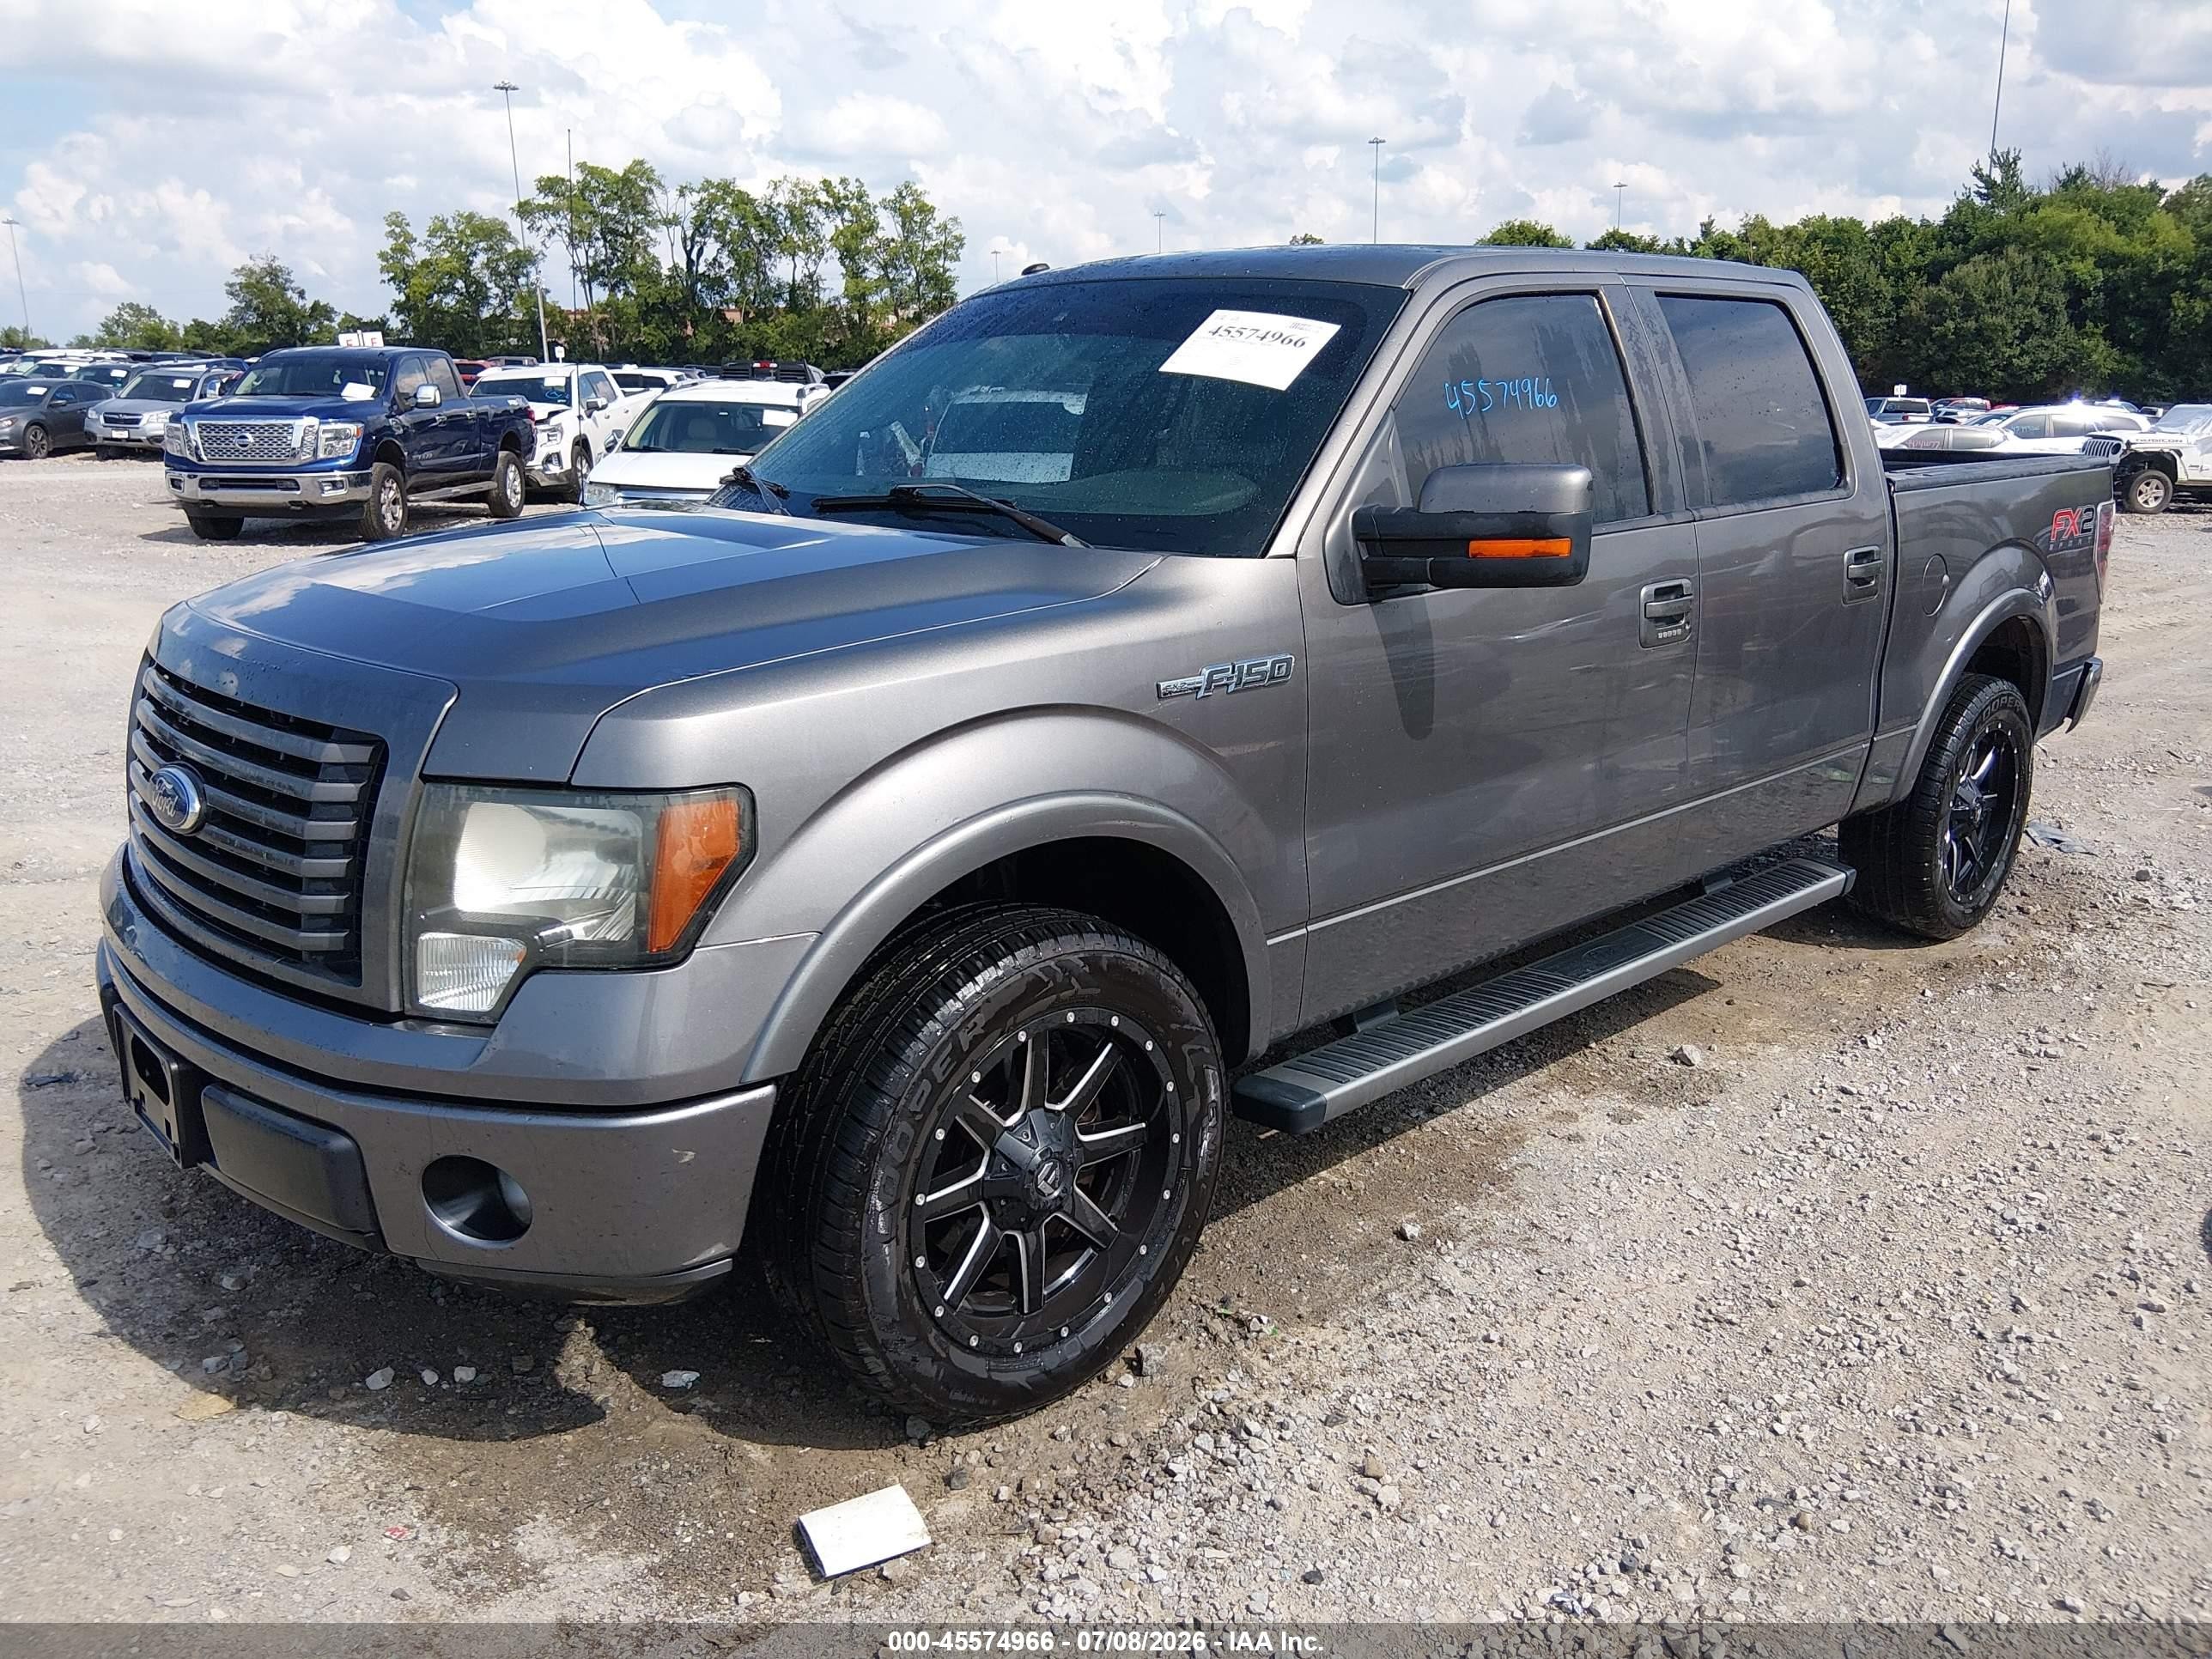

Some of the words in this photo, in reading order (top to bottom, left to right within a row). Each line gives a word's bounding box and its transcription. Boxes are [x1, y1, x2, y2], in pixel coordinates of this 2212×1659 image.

[1208, 324, 1307, 349] 45574966
[1444, 377, 1559, 420] 45574966
[2050, 504, 2096, 542] FX2
[1196, 653, 1295, 700] F-150
[1975, 696, 2021, 732] COOPER
[152, 776, 179, 818] Ford
[877, 1012, 988, 1235] COOPER
